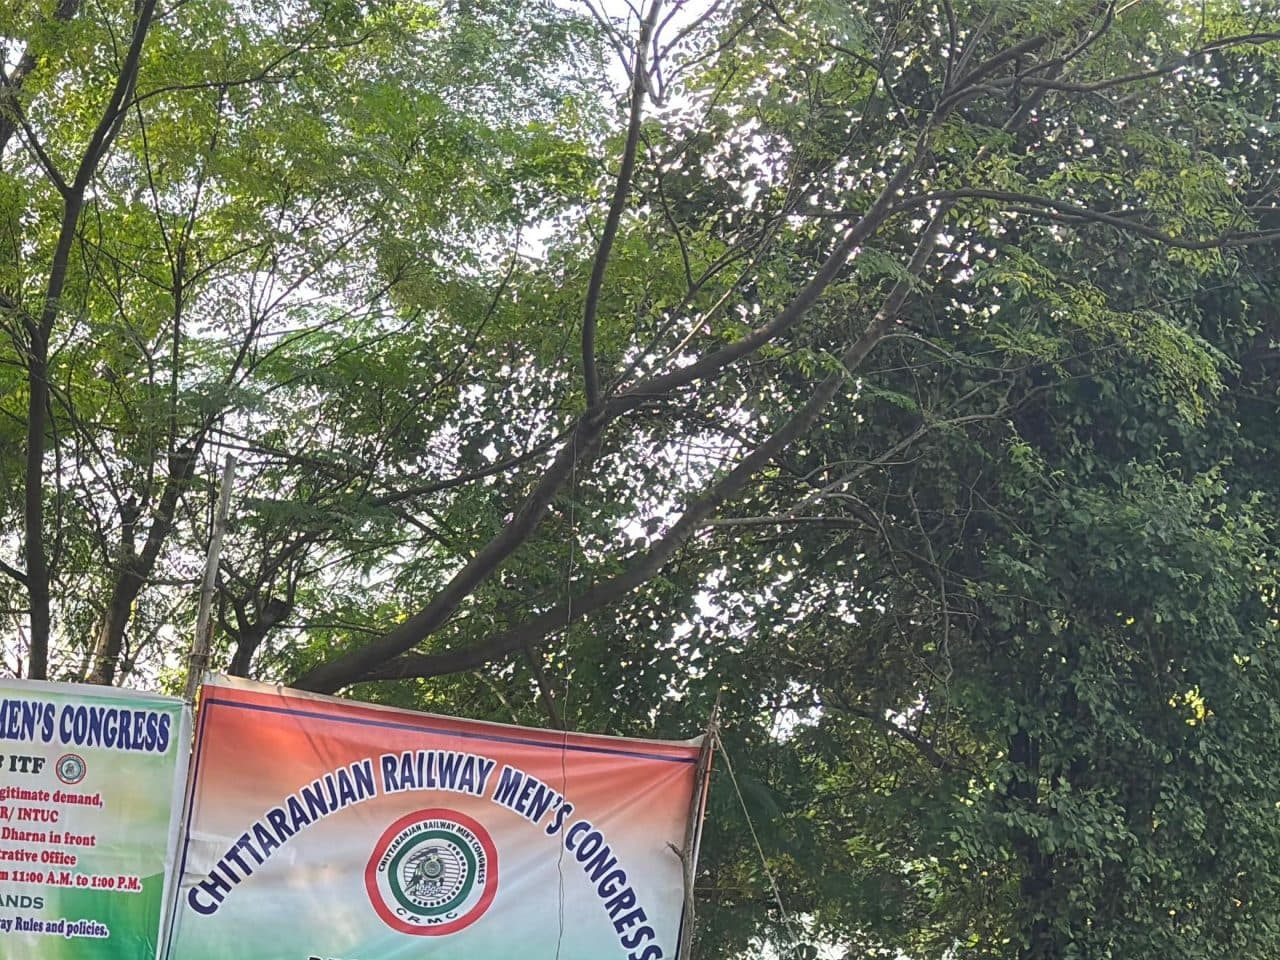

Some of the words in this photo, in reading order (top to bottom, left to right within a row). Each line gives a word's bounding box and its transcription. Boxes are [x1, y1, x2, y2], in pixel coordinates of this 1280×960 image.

[60, 704, 170, 752] CONGRESS
[10, 755, 45, 774] ITF
[53, 790, 103, 807] demand,
[18, 807, 59, 822] INTUC
[1, 827, 46, 842] Dharna
[49, 831, 61, 844] in
[64, 833, 96, 846] front
[188, 760, 374, 915] CHITTARANJAN
[382, 753, 493, 794] RAILWAY
[493, 767, 572, 834] MEN'S
[379, 825, 422, 872] CHITTARANJAN
[423, 821, 456, 831] RAILWAY
[41, 850, 76, 865] Office
[12, 870, 42, 882] 11:00
[46, 872, 72, 885] A.M.
[76, 874, 88, 886] to
[92, 876, 114, 888] 1:00
[118, 877, 141, 890] P.M.
[15, 917, 43, 932] Rules
[46, 920, 65, 934] and
[67, 922, 108, 936] policies.
